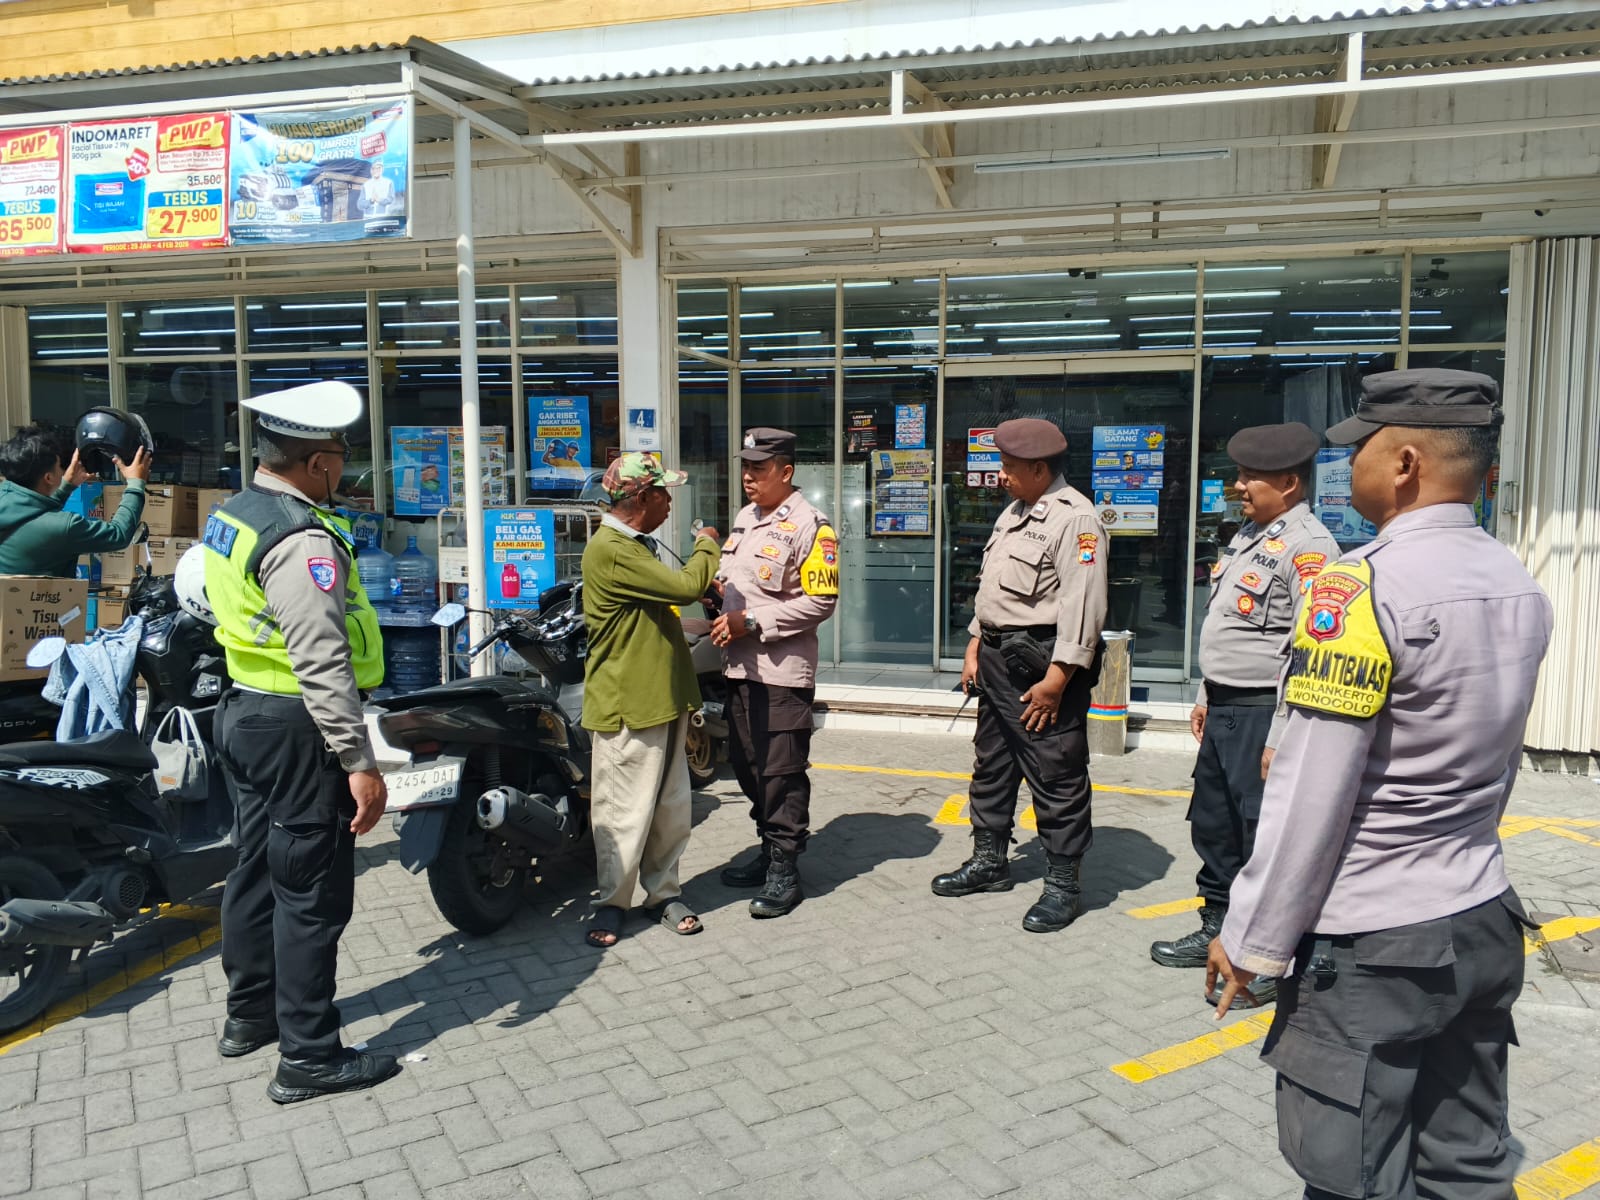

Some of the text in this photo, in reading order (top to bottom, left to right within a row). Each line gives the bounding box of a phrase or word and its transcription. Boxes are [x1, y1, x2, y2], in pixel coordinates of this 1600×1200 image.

[72, 126, 152, 144] INDOMARET
[169, 121, 212, 143] PWP
[9, 134, 48, 155] PWP
[320, 136, 357, 149] UMROH
[275, 142, 315, 163] 100
[318, 149, 354, 161] GRATIS
[163, 191, 208, 206] TEBUS
[4, 200, 40, 215] TEBUS
[236, 201, 258, 220] 10
[160, 208, 218, 234] 27.900
[139, 242, 152, 250] JAN
[538, 411, 579, 420] GAK RIBET
[636, 410, 645, 428] 4
[1103, 428, 1140, 436] SELAMAT
[1104, 435, 1138, 443] DATANG
[495, 525, 542, 534] BELI GAS
[1023, 530, 1047, 542] POLRI
[766, 530, 795, 545] POLRI
[1251, 553, 1279, 570] POLRI
[33, 609, 58, 623] Tisu
[1294, 691, 1372, 715] WONOCOLO
[395, 773, 427, 789] 2454
[433, 768, 455, 784] DAT
